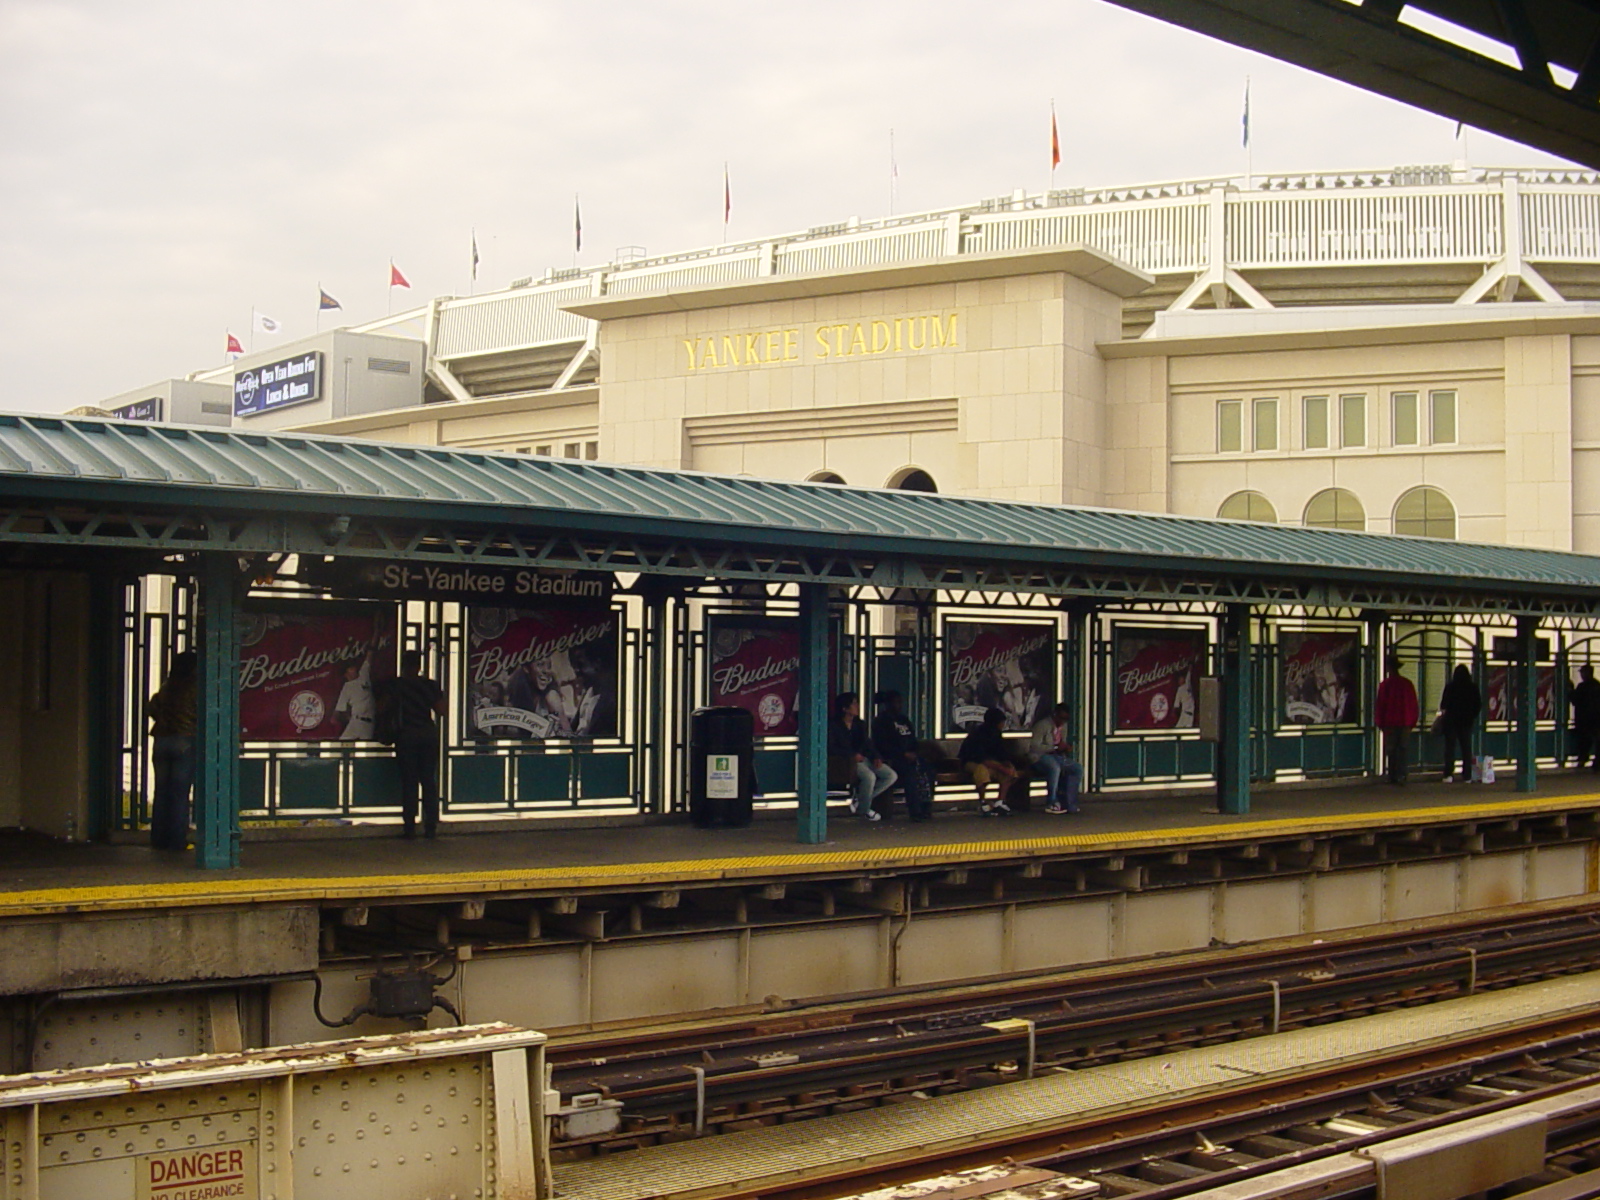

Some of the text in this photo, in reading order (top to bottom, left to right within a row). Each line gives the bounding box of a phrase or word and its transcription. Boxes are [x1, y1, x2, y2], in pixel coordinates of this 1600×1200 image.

[683, 313, 960, 371] YANKEE STADIUM
[383, 564, 603, 597] St-Yankee Stadium
[239, 636, 391, 691] Budweisr
[471, 620, 611, 684] Budweiser
[950, 633, 1049, 687] Budweiser
[712, 655, 800, 696] Budwei
[1119, 654, 1199, 695] Budweis
[481, 710, 521, 723] American
[522, 714, 546, 731] Lager
[150, 1149, 243, 1183] DANGER
[174, 1183, 245, 1200] CLEARANCE
